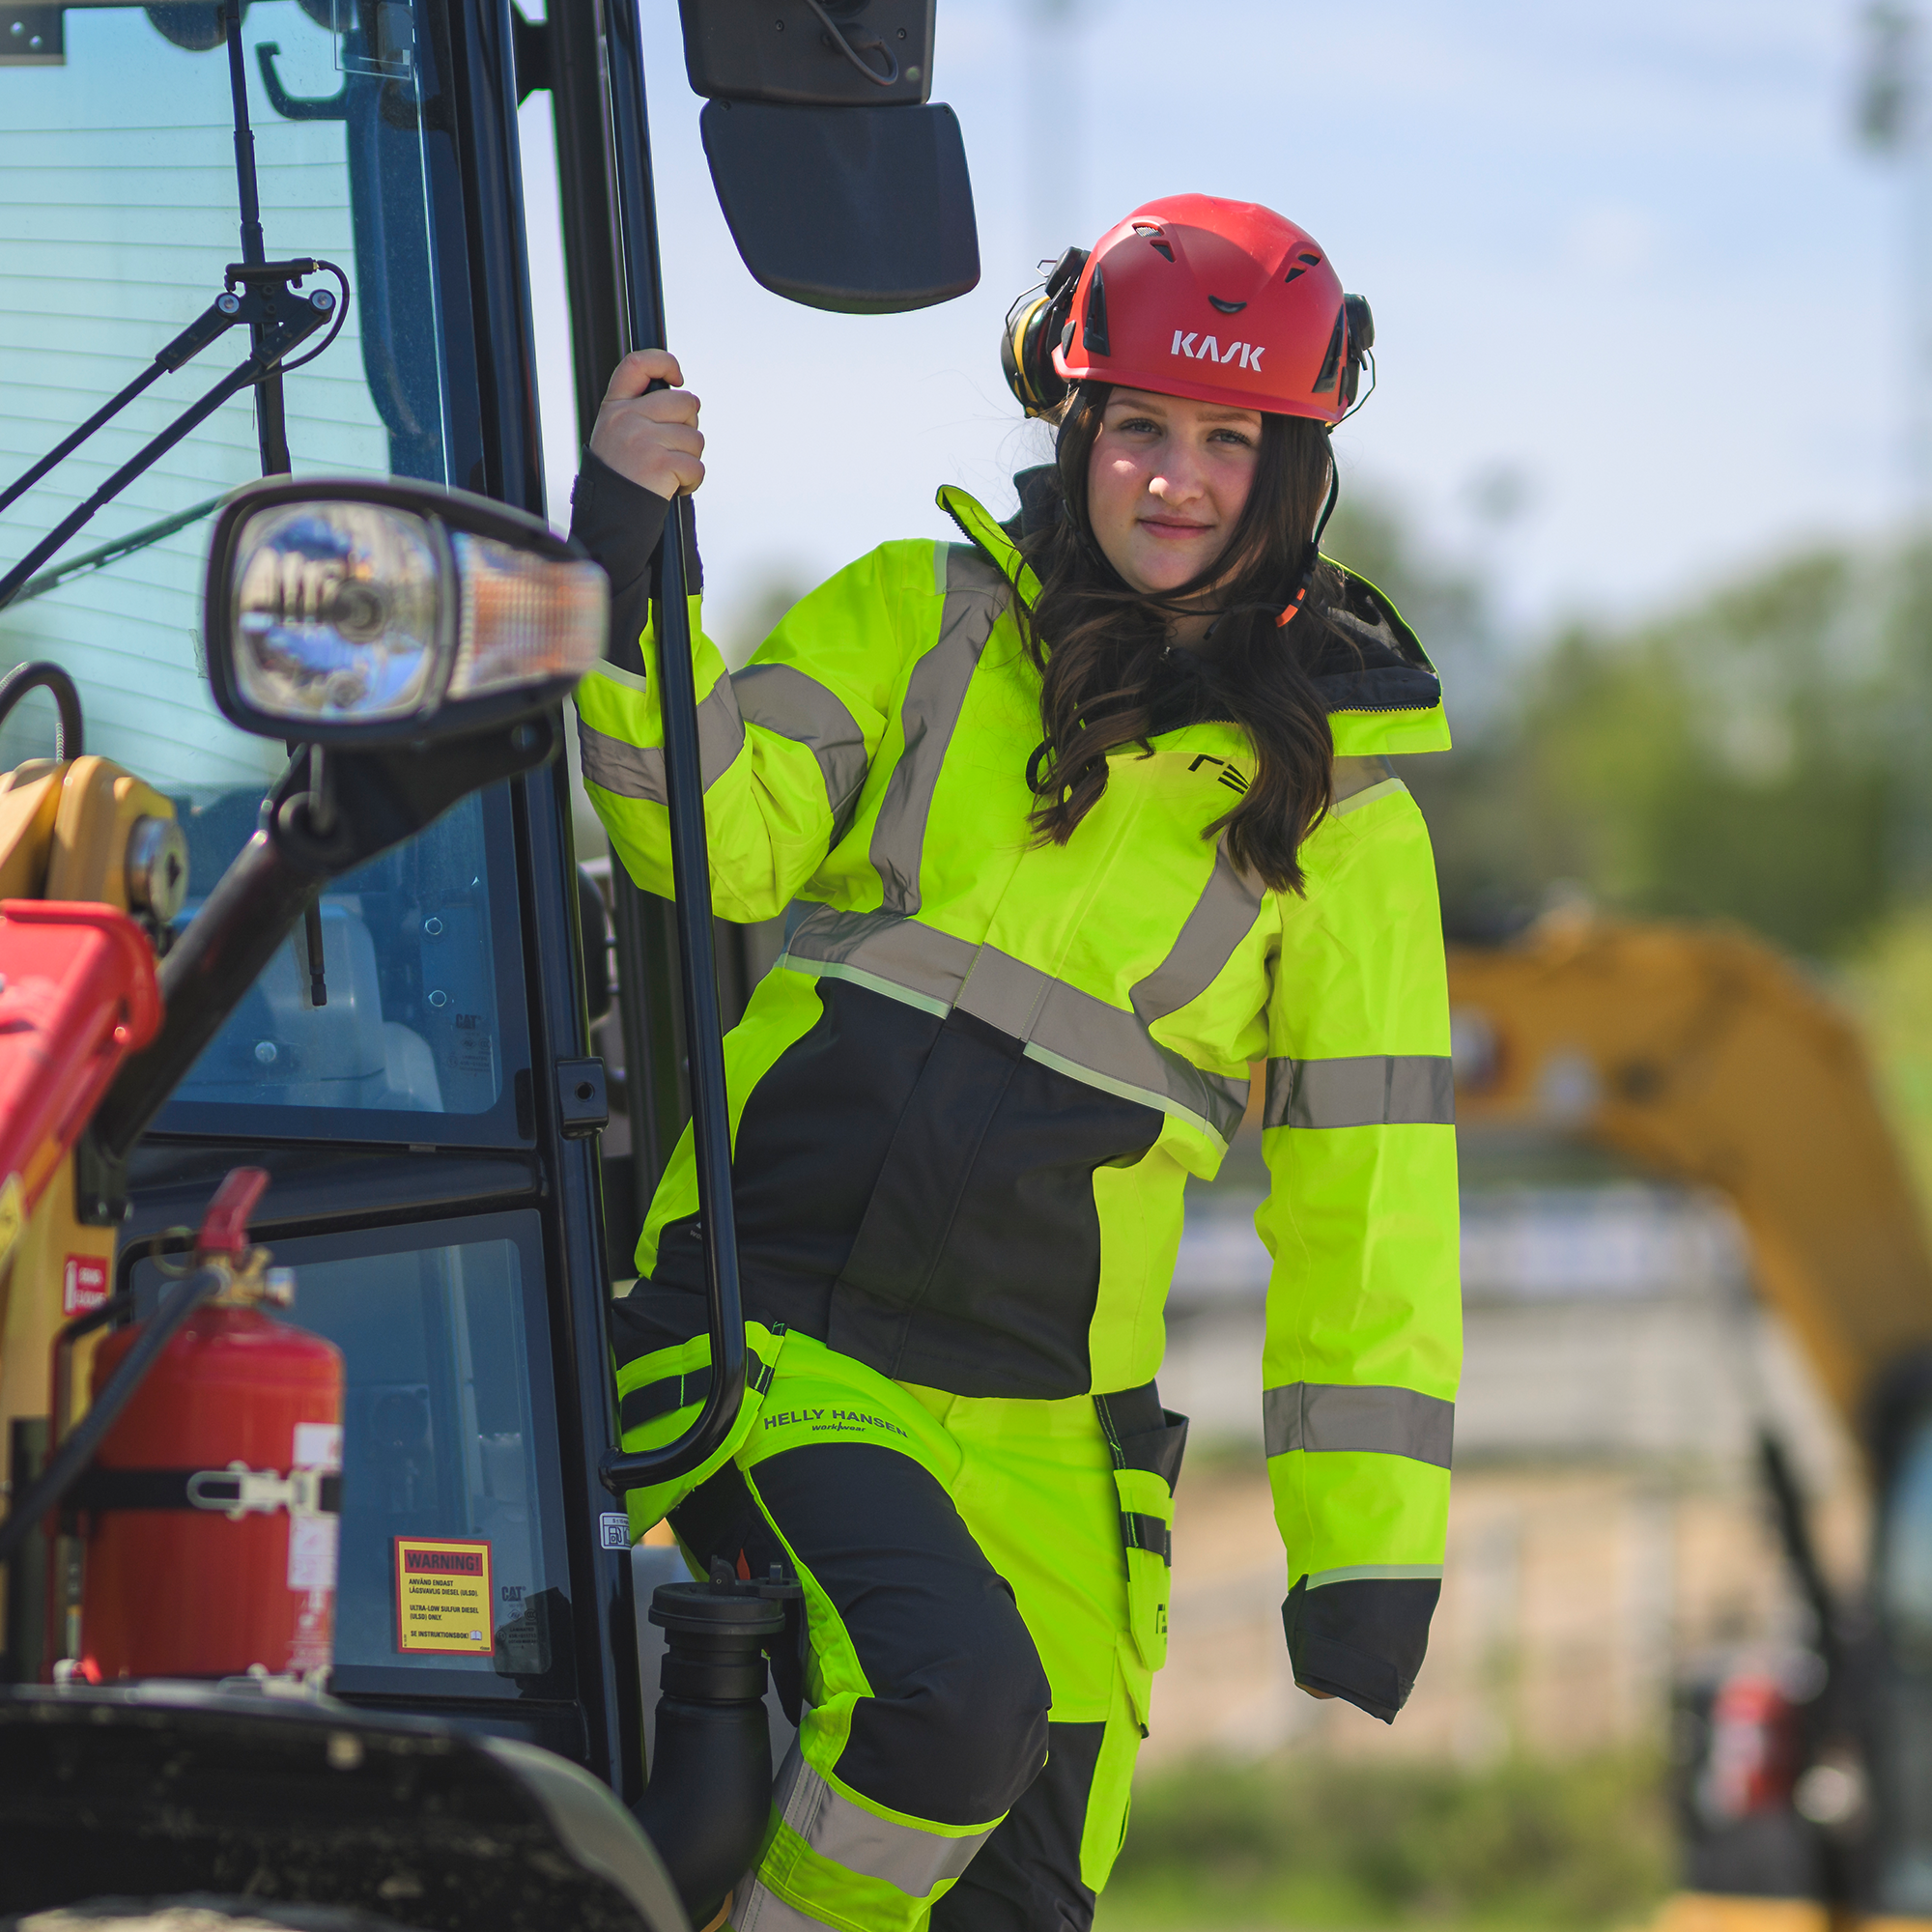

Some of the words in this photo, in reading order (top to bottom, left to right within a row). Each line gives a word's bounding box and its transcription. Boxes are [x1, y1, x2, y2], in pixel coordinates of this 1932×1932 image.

[1171, 329, 1265, 372] KASK
[456, 1013, 477, 1030] CAT
[764, 1409, 825, 1430] HELLY
[832, 1409, 909, 1438] HANSEN
[407, 1552, 480, 1572] WARNING!
[409, 1586, 440, 1595] LÅGSVAVLIG
[501, 1585, 522, 1602] CAT
[418, 1631, 469, 1639] INSTRUKTIONSBOK!
